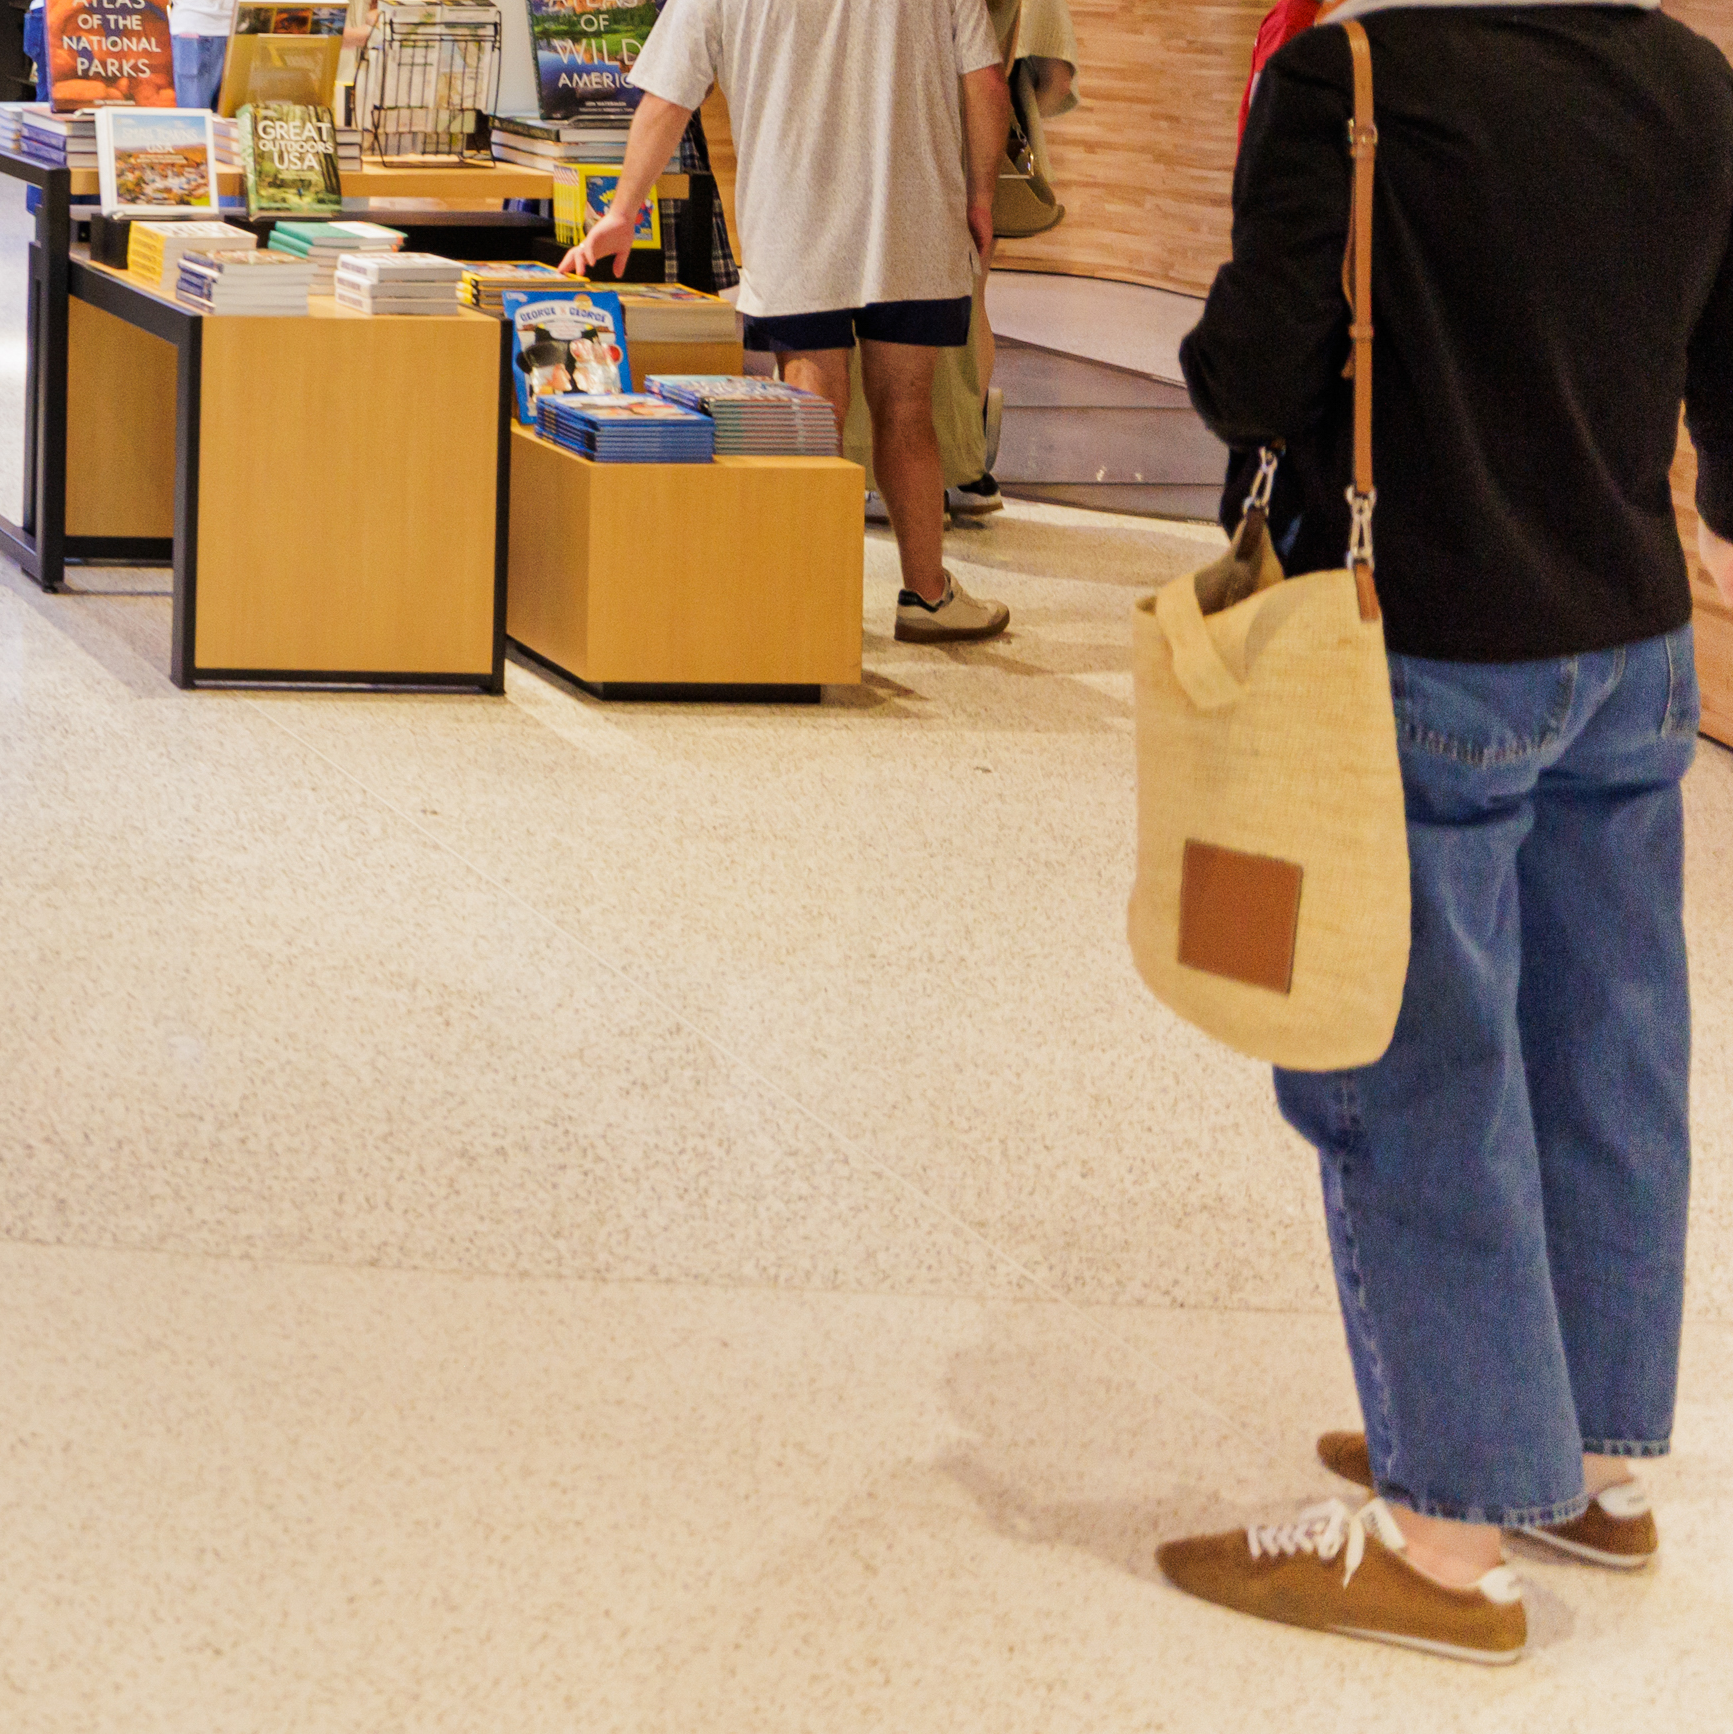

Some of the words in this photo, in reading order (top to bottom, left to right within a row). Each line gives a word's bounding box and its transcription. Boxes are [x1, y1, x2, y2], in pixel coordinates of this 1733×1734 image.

[77, 13, 103, 30] OF
[106, 14, 143, 31] THE
[580, 14, 610, 32] OF
[62, 35, 162, 53] NATIONAL
[553, 38, 643, 66] WILD
[76, 57, 152, 79] PARKS
[558, 72, 636, 89] AMERIC
[257, 120, 332, 141] GREAT
[258, 139, 334, 154] OUTDOORS
[274, 152, 320, 170] USA
